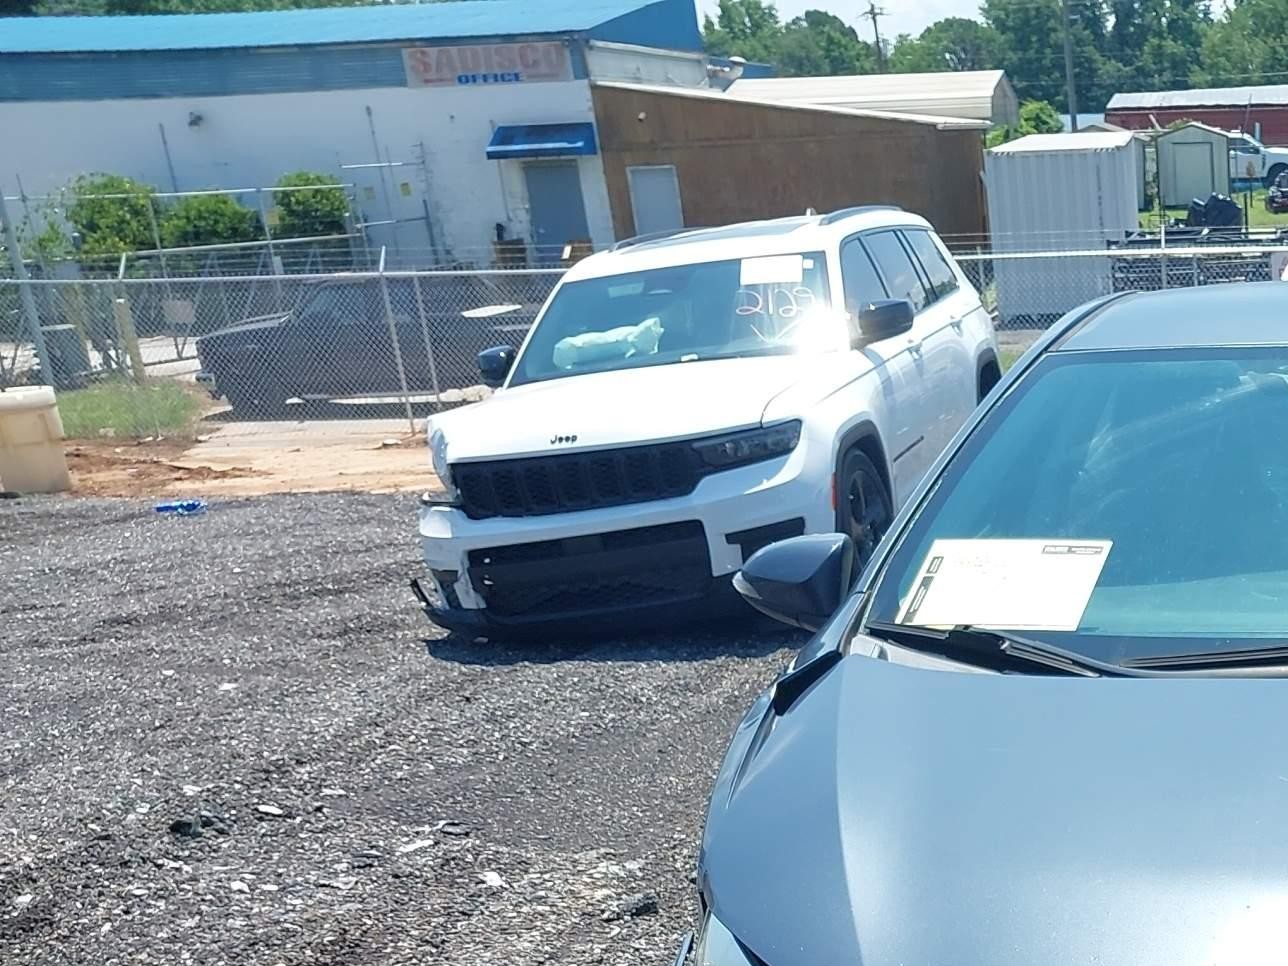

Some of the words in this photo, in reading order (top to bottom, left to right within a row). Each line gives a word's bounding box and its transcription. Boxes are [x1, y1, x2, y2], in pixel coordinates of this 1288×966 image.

[408, 44, 566, 74] SADISCO
[457, 72, 523, 85] OFFICE
[550, 435, 578, 445] Jeep
